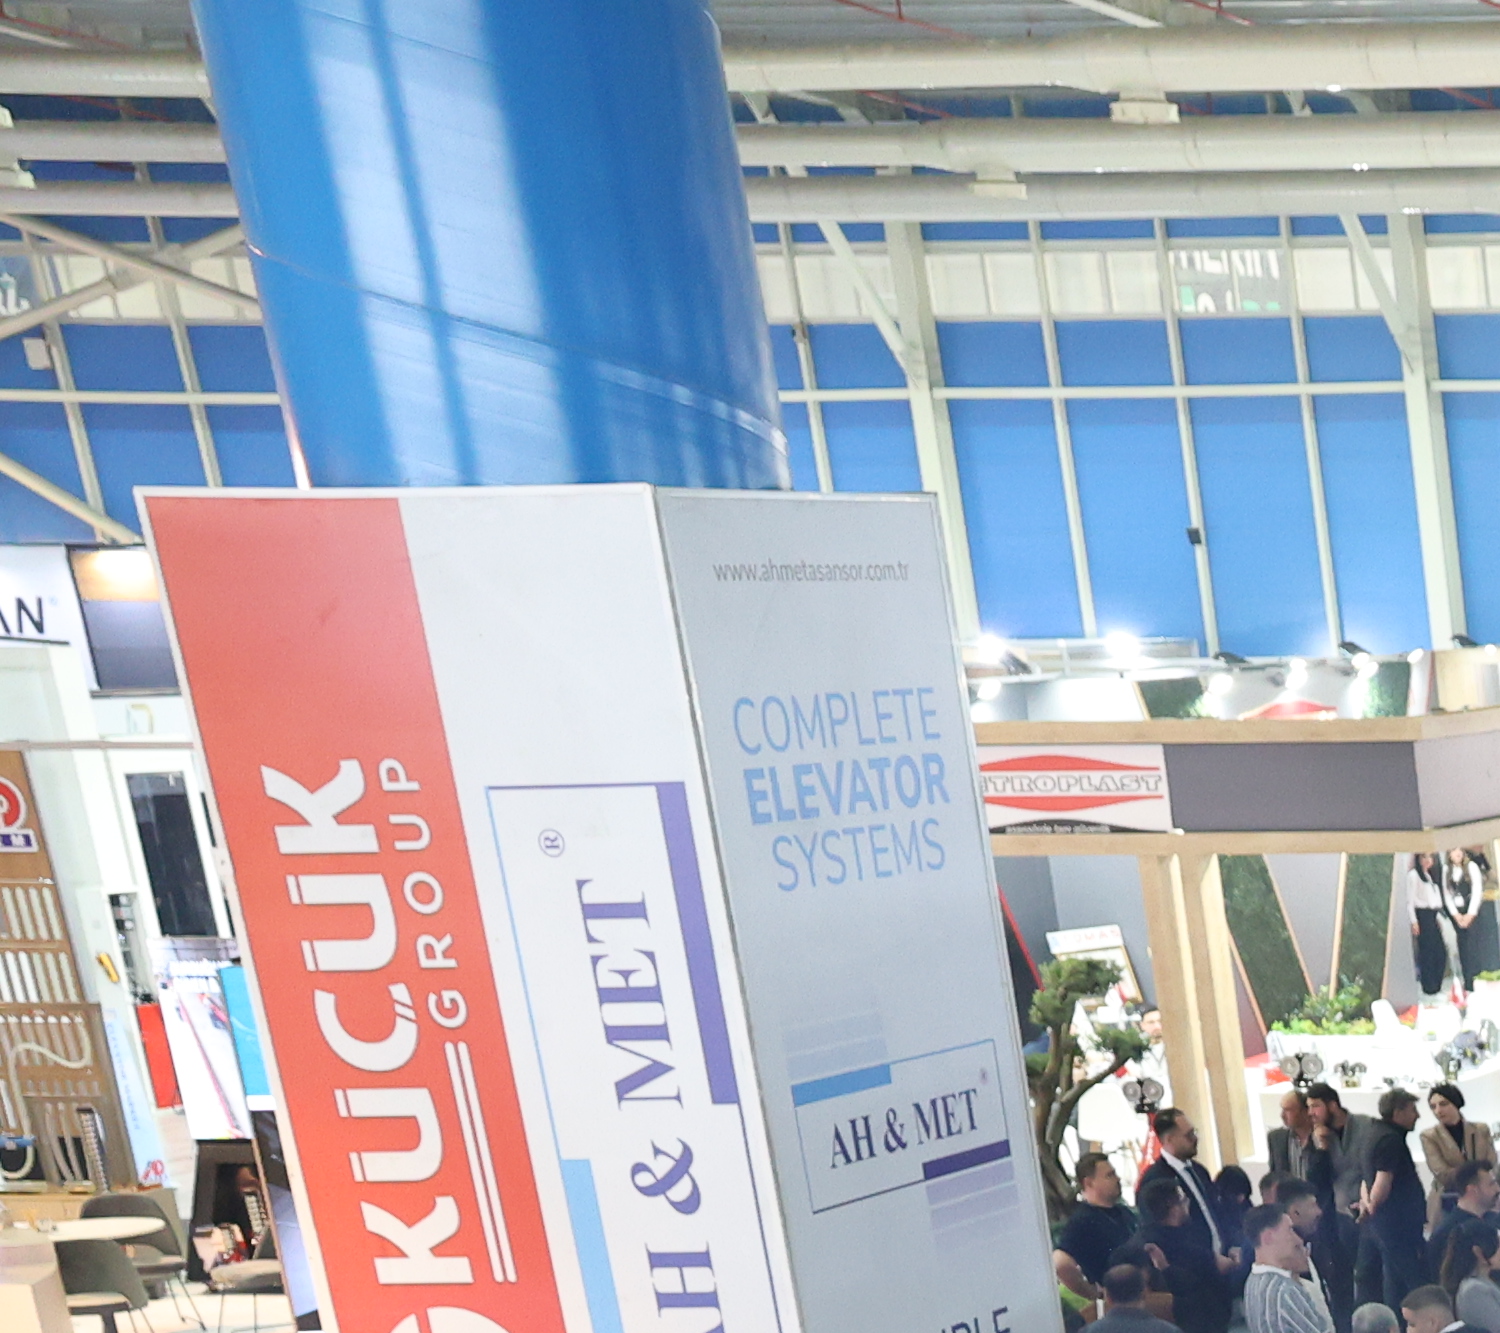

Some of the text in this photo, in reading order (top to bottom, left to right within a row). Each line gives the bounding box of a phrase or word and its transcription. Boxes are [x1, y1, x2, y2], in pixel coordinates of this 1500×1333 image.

[713, 558, 909, 583] www.ahmetasansor.com.tr
[733, 687, 942, 756] COMPLETE
[743, 752, 951, 826] ELEVATOR
[771, 817, 946, 892] SYSTEMS
[379, 756, 468, 1031] GROUP
[576, 877, 684, 1112] MET
[830, 1088, 978, 1169] AH & MET
[630, 1138, 700, 1216] &
